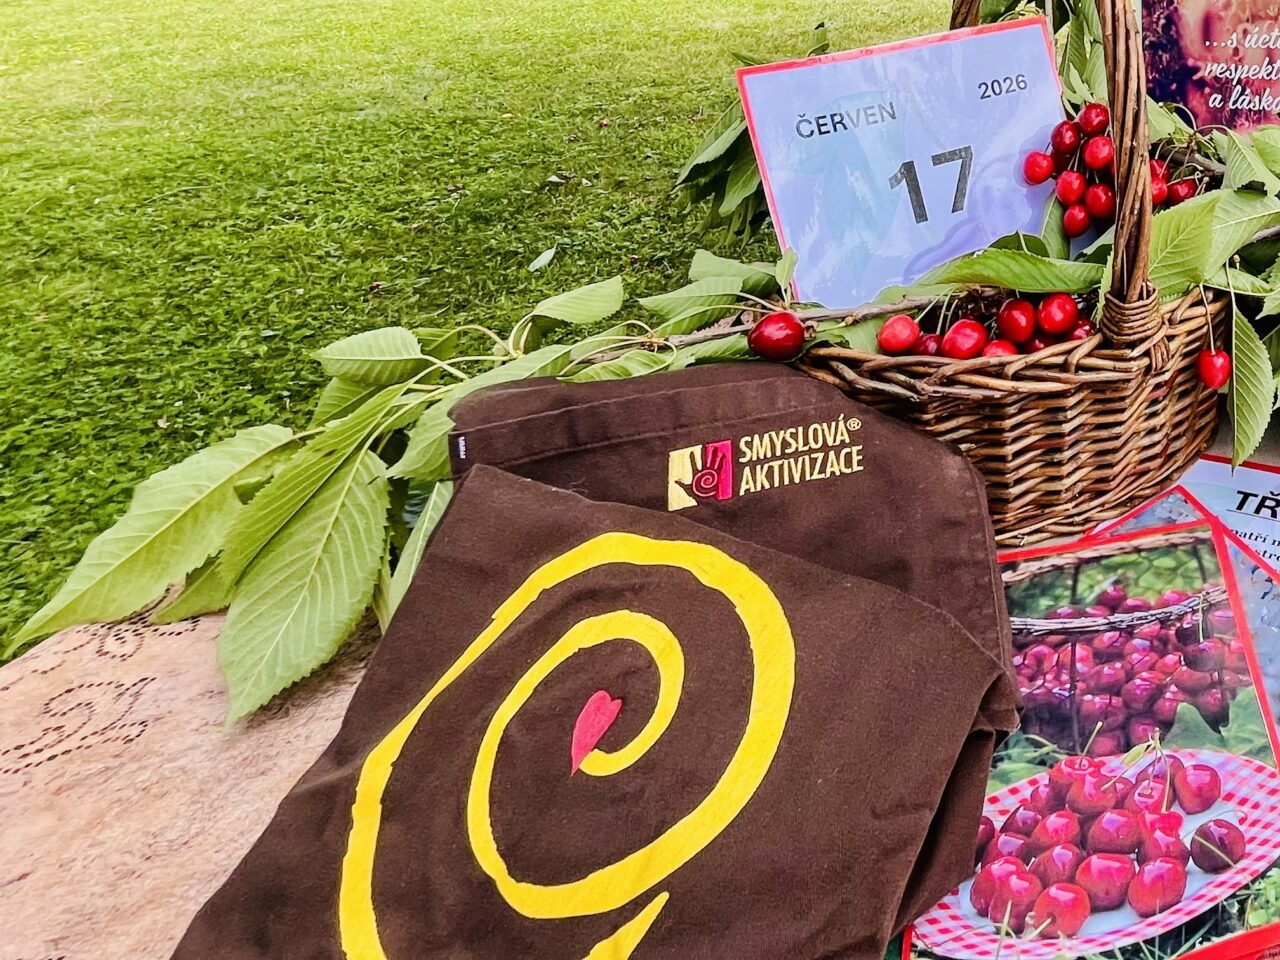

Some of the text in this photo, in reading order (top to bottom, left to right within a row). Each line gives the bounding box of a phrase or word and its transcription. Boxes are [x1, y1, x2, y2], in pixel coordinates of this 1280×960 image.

[977, 74, 1028, 100] 2026
[1208, 93, 1223, 108] a
[796, 101, 897, 139] ČERVEN
[888, 145, 974, 224] 17
[739, 445, 864, 496] AKTIVIZACE
